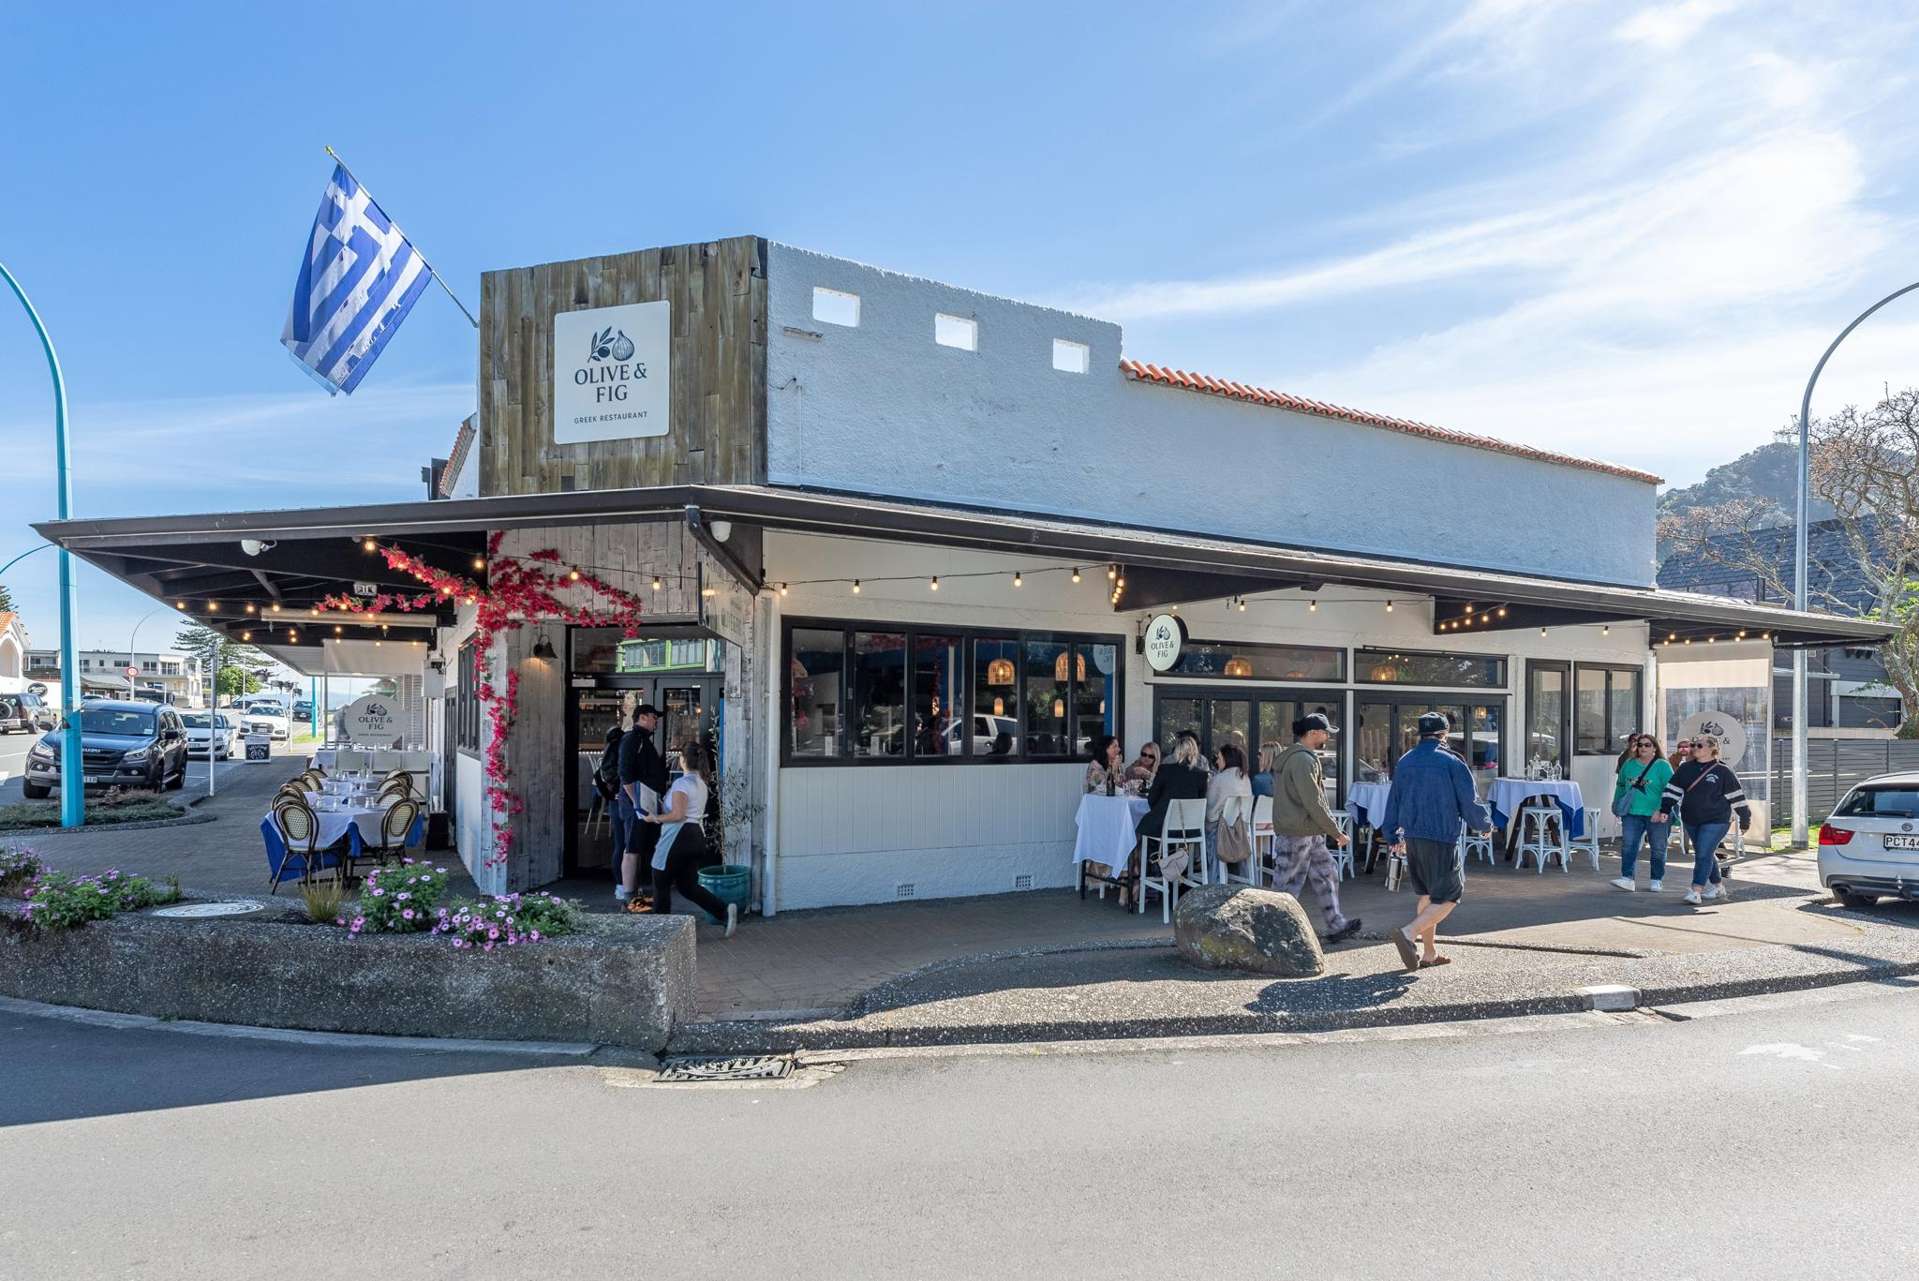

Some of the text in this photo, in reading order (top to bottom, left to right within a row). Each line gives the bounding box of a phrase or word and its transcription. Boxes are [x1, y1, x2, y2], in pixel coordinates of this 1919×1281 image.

[575, 362, 648, 385] OLIVE &
[596, 384, 628, 403] FIG
[574, 411, 648, 425] GREEK RESTAURANT
[1151, 641, 1174, 650] OLIVE &
[1157, 650, 1169, 658] FIG
